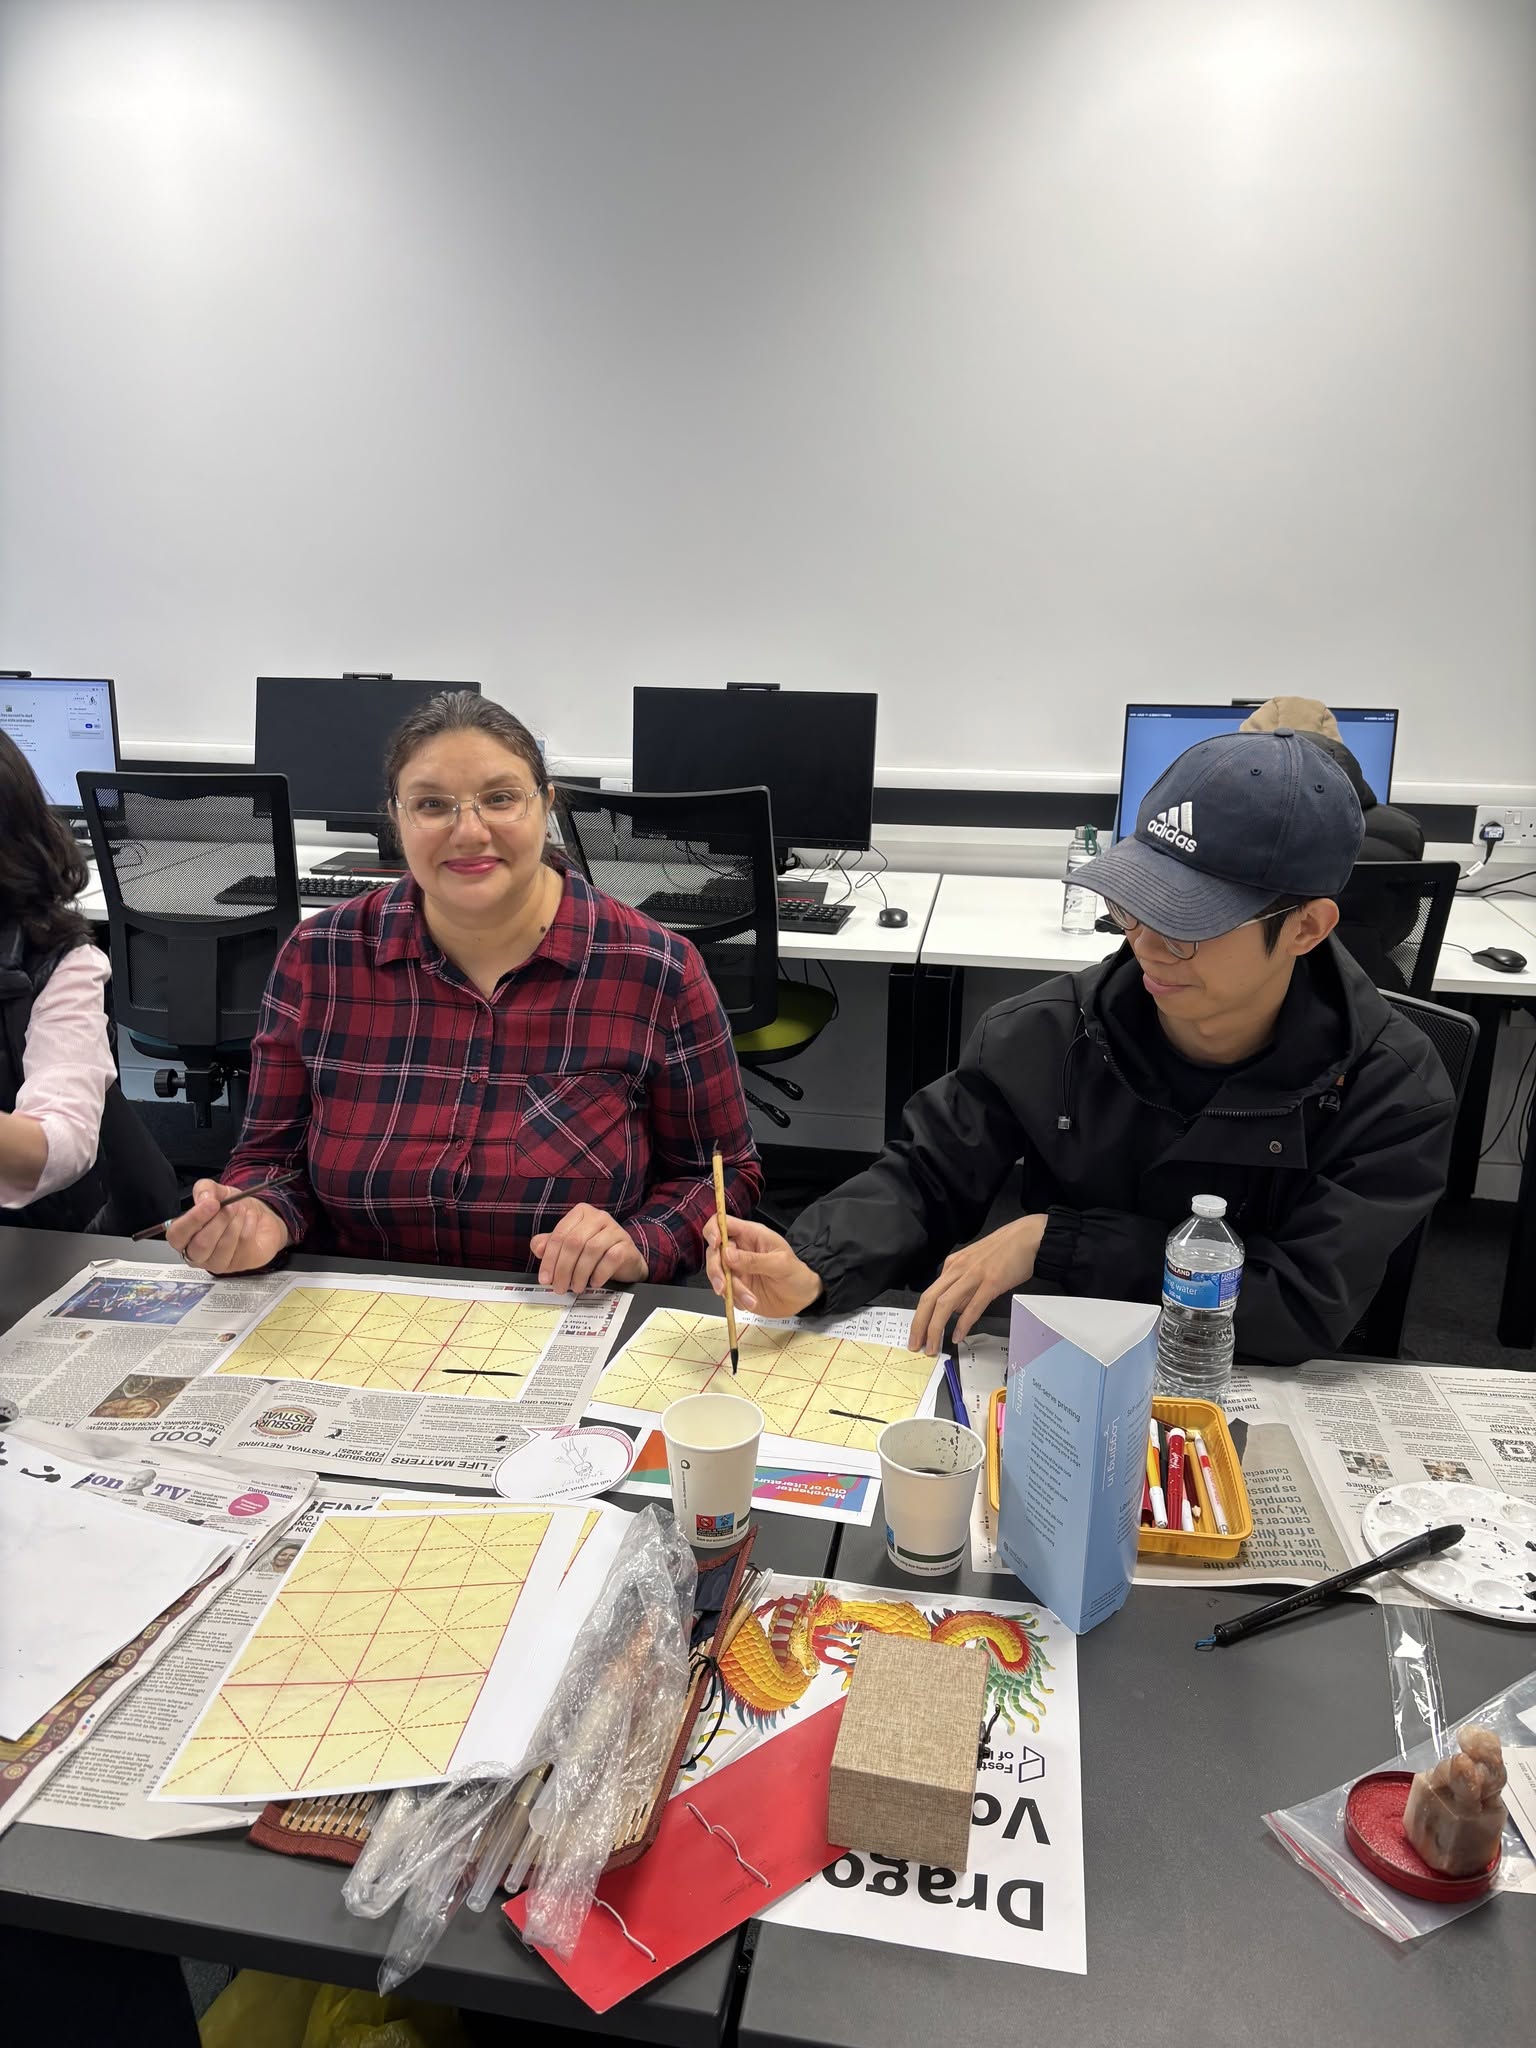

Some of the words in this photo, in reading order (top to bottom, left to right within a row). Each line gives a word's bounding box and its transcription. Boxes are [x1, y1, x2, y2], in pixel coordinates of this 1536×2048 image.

[1147, 819, 1198, 853] adidas
[1176, 1284, 1198, 1296] water
[1032, 1377, 1057, 1404] Self-serve
[1057, 1398, 1081, 1423] printing
[1244, 1403, 1261, 1411] The
[261, 1411, 317, 1425] FESTIVAL
[249, 1419, 314, 1433] DIDSBURY
[207, 1427, 223, 1436] THE
[150, 1431, 218, 1447] FOOD
[1107, 1415, 1121, 1472] Logging
[236, 1441, 284, 1451] RETURNS
[286, 1444, 331, 1457] FESTIVAL
[337, 1447, 363, 1456] 2025!
[364, 1450, 387, 1458] FOR
[332, 1452, 382, 1464] DIDSBURY
[390, 1457, 456, 1468] MATTERS
[457, 1461, 489, 1471] LIFE
[753, 1477, 808, 1489] Literature
[1107, 1472, 1116, 1488] in
[151, 1482, 192, 1501] TV
[247, 1486, 293, 1500] Entertainment
[570, 1484, 589, 1492] what
[774, 1485, 846, 1500] Manchester
[823, 1485, 847, 1495] City
[1282, 1485, 1297, 1493] as
[1249, 1495, 1303, 1507] complet
[1259, 1505, 1284, 1515] you
[1284, 1505, 1307, 1515] kit,
[1265, 1516, 1311, 1526] cancer
[1277, 1527, 1306, 1537] free
[1306, 1526, 1315, 1535] a
[1281, 1538, 1292, 1548] If
[1293, 1538, 1321, 1548] life.
[1250, 1549, 1287, 1559] could
[1287, 1548, 1326, 1559] toilet
[1203, 1561, 1225, 1571] the
[1226, 1561, 1241, 1571] to
[1242, 1556, 1267, 1571] trip
[1267, 1558, 1299, 1569] next
[998, 1751, 1014, 1761] of
